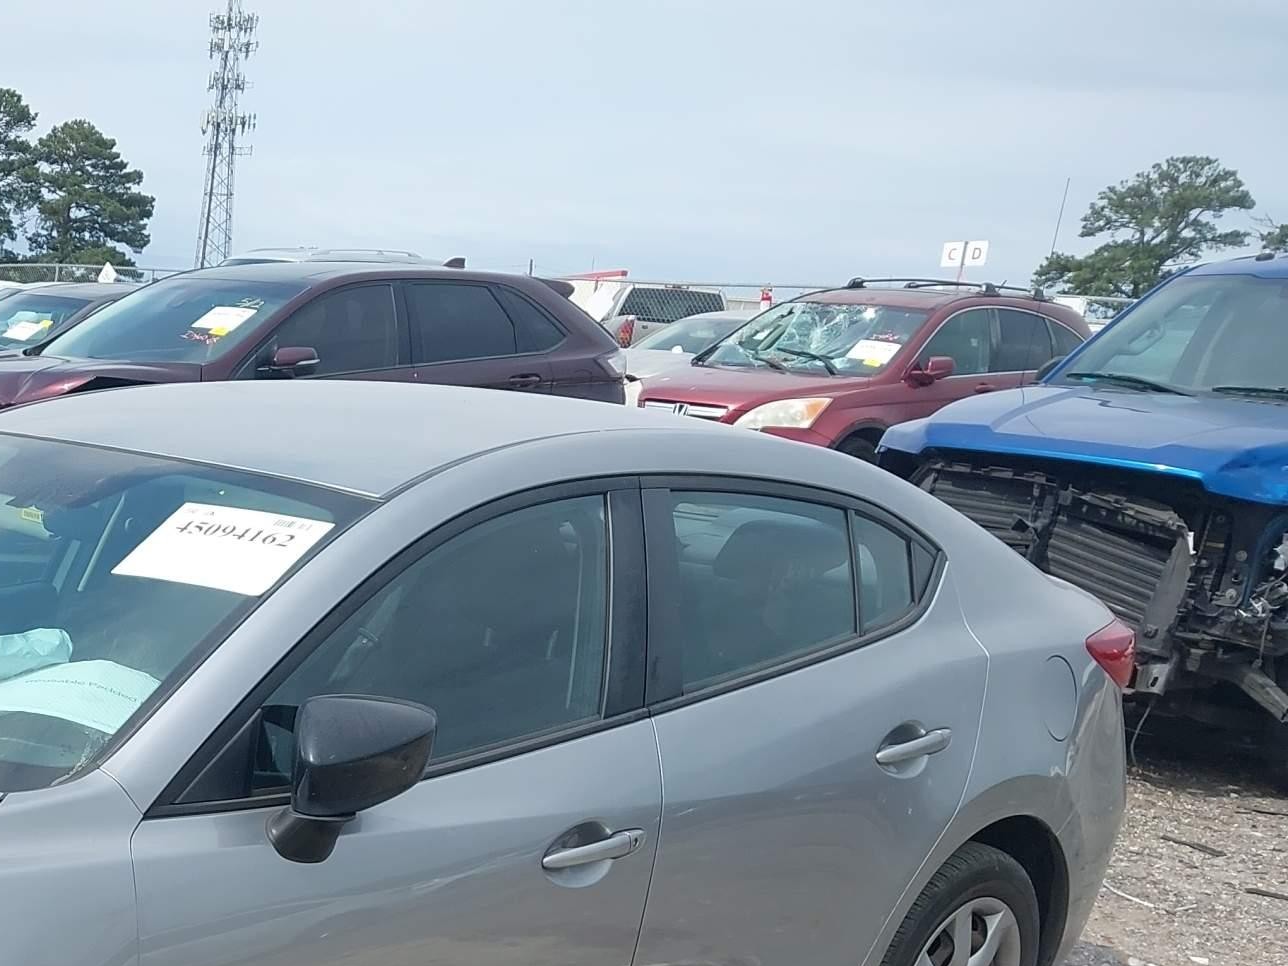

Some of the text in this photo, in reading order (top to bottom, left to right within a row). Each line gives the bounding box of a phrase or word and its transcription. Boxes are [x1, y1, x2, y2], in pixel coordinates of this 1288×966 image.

[948, 247, 958, 261] C
[971, 247, 982, 260] D
[175, 520, 296, 548] 45094162
